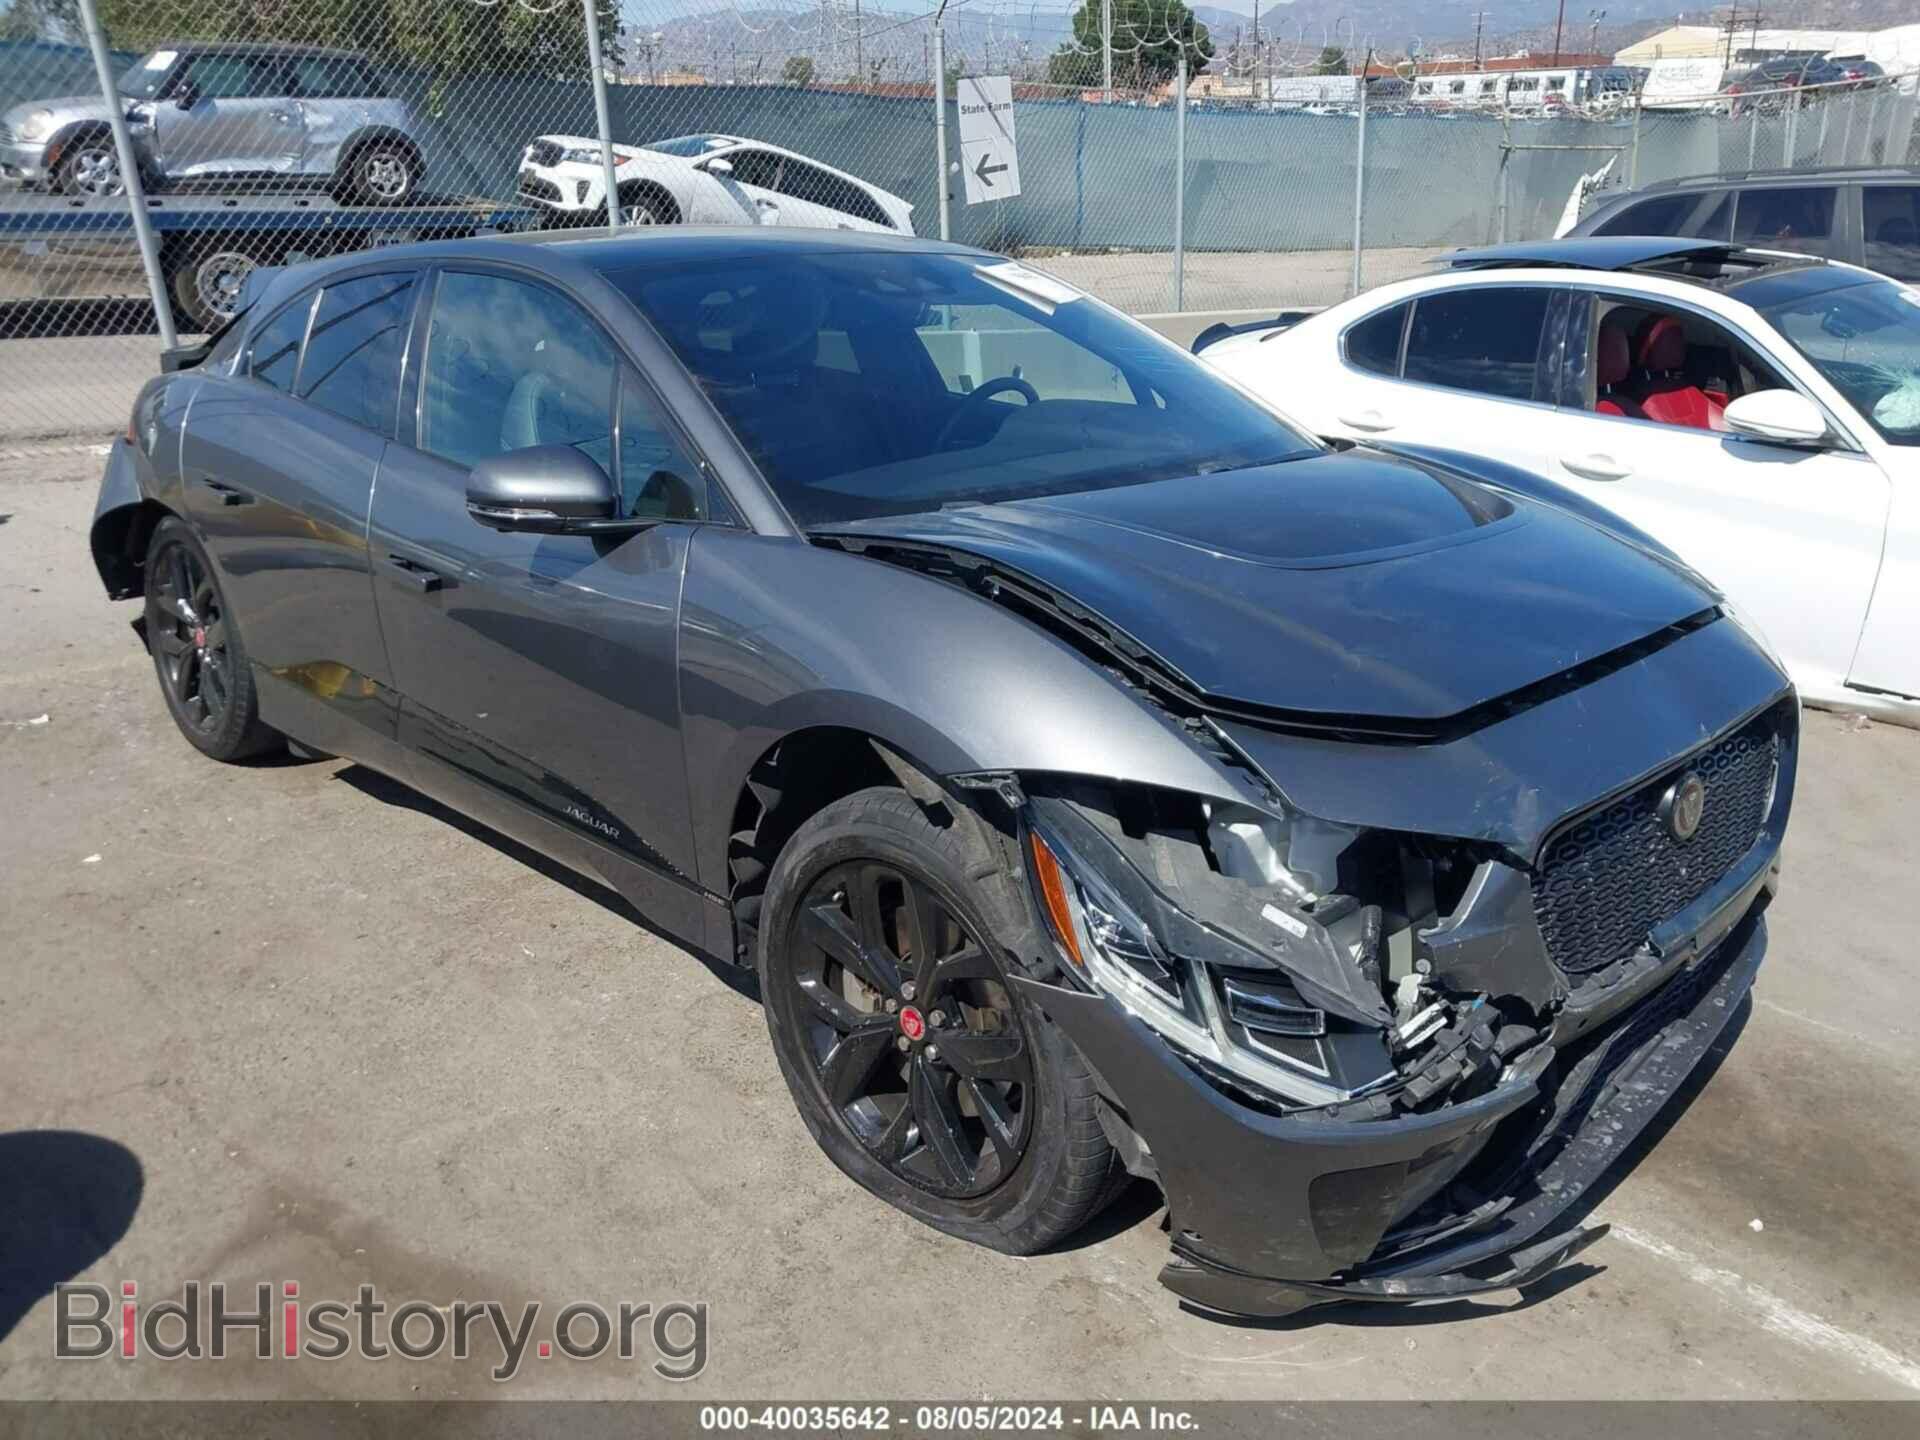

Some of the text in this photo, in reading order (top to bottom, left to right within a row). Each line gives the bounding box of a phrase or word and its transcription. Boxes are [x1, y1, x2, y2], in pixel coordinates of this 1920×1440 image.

[961, 102, 1012, 115] State Farm
[562, 805, 622, 839] JAGUAR
